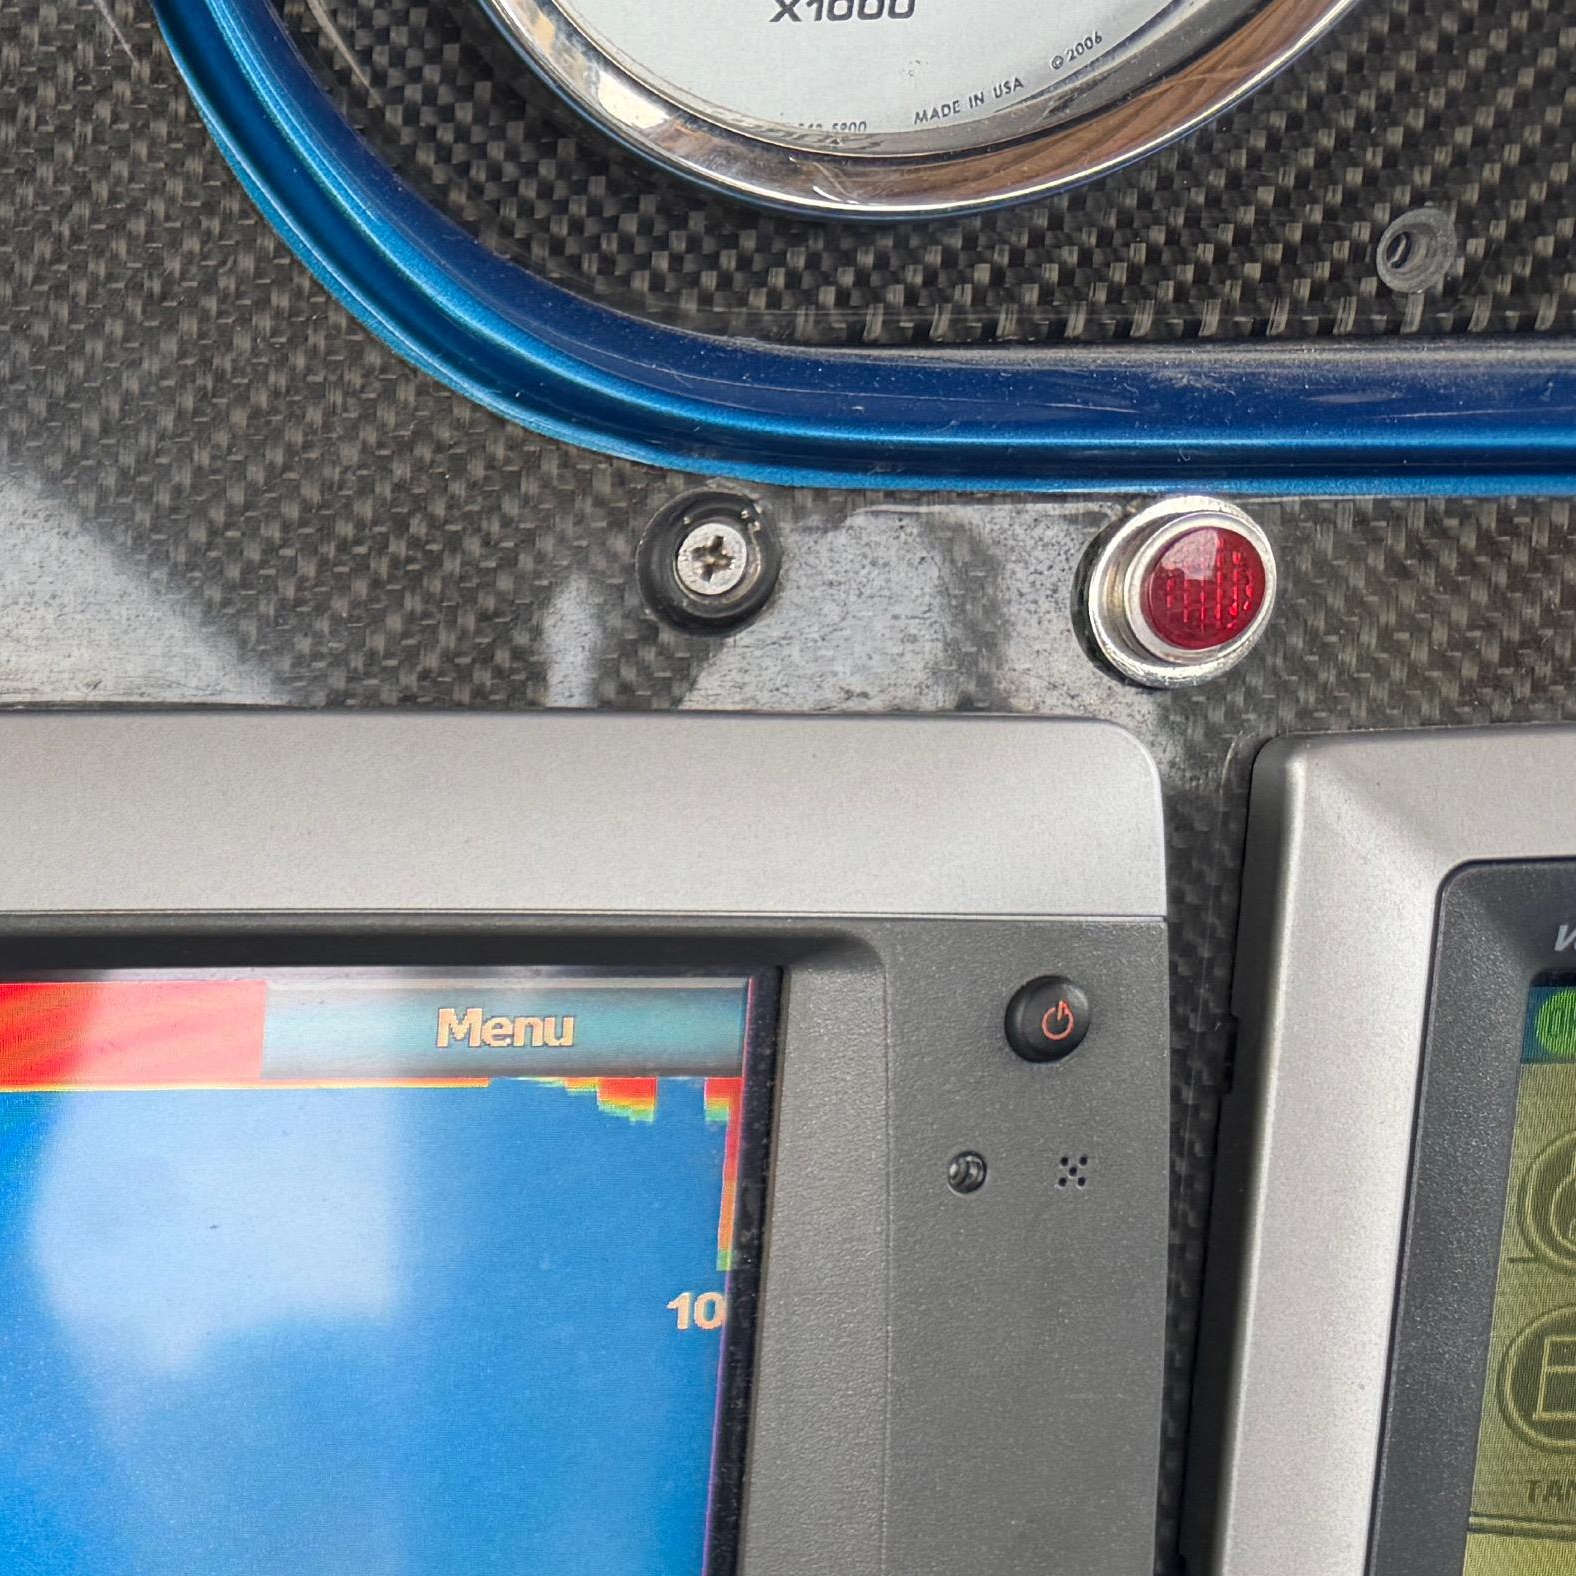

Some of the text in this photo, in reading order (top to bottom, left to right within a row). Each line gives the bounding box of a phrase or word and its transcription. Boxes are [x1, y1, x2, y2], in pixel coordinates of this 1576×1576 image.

[914, 77, 1025, 125] MADE IN USA
[436, 1007, 575, 1048] Menu
[667, 1292, 726, 1330] 10
